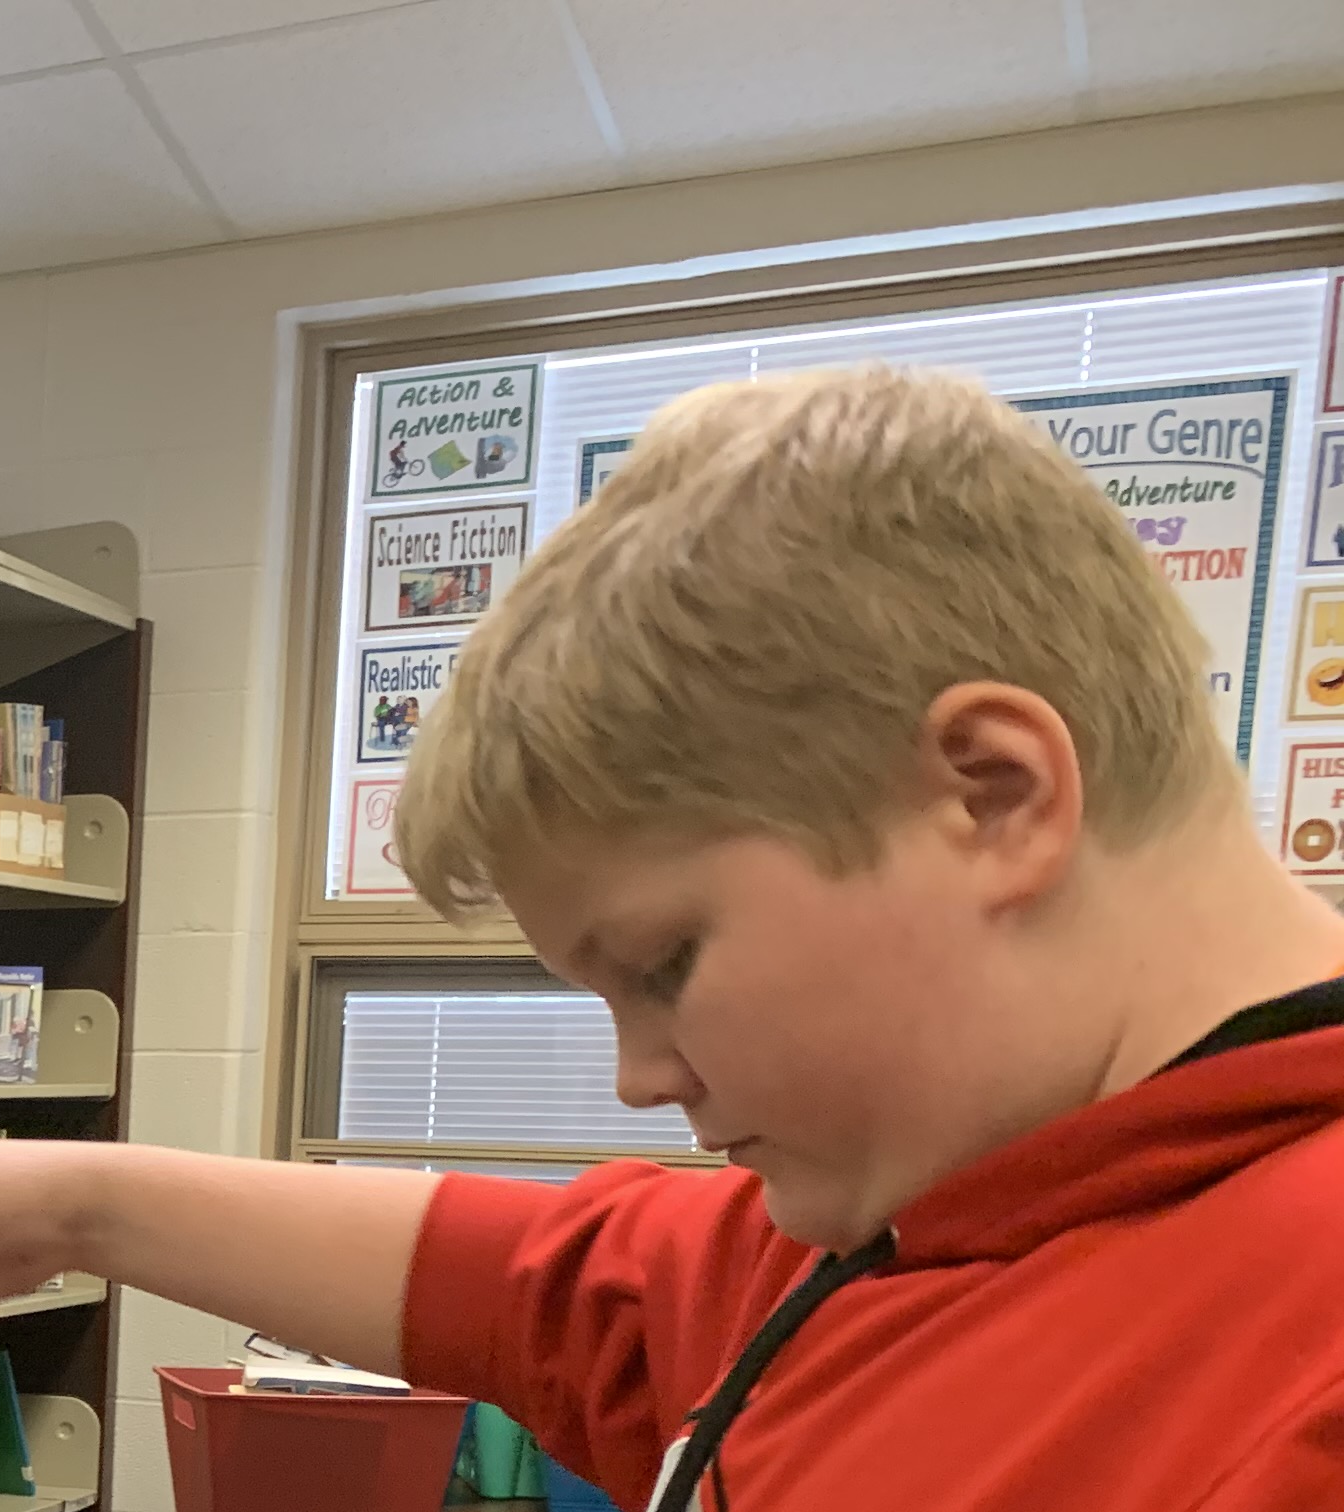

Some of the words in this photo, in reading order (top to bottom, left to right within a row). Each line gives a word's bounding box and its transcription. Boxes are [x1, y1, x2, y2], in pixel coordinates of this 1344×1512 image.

[397, 380, 481, 408] Action
[493, 376, 515, 398] &
[388, 406, 523, 440] Adventure
[1048, 418, 1137, 459] Your
[1148, 408, 1263, 464] Genre
[1103, 475, 1237, 507] Adventure
[377, 523, 441, 568] Science
[449, 514, 516, 561] Fiction
[368, 654, 442, 694] Realistic
